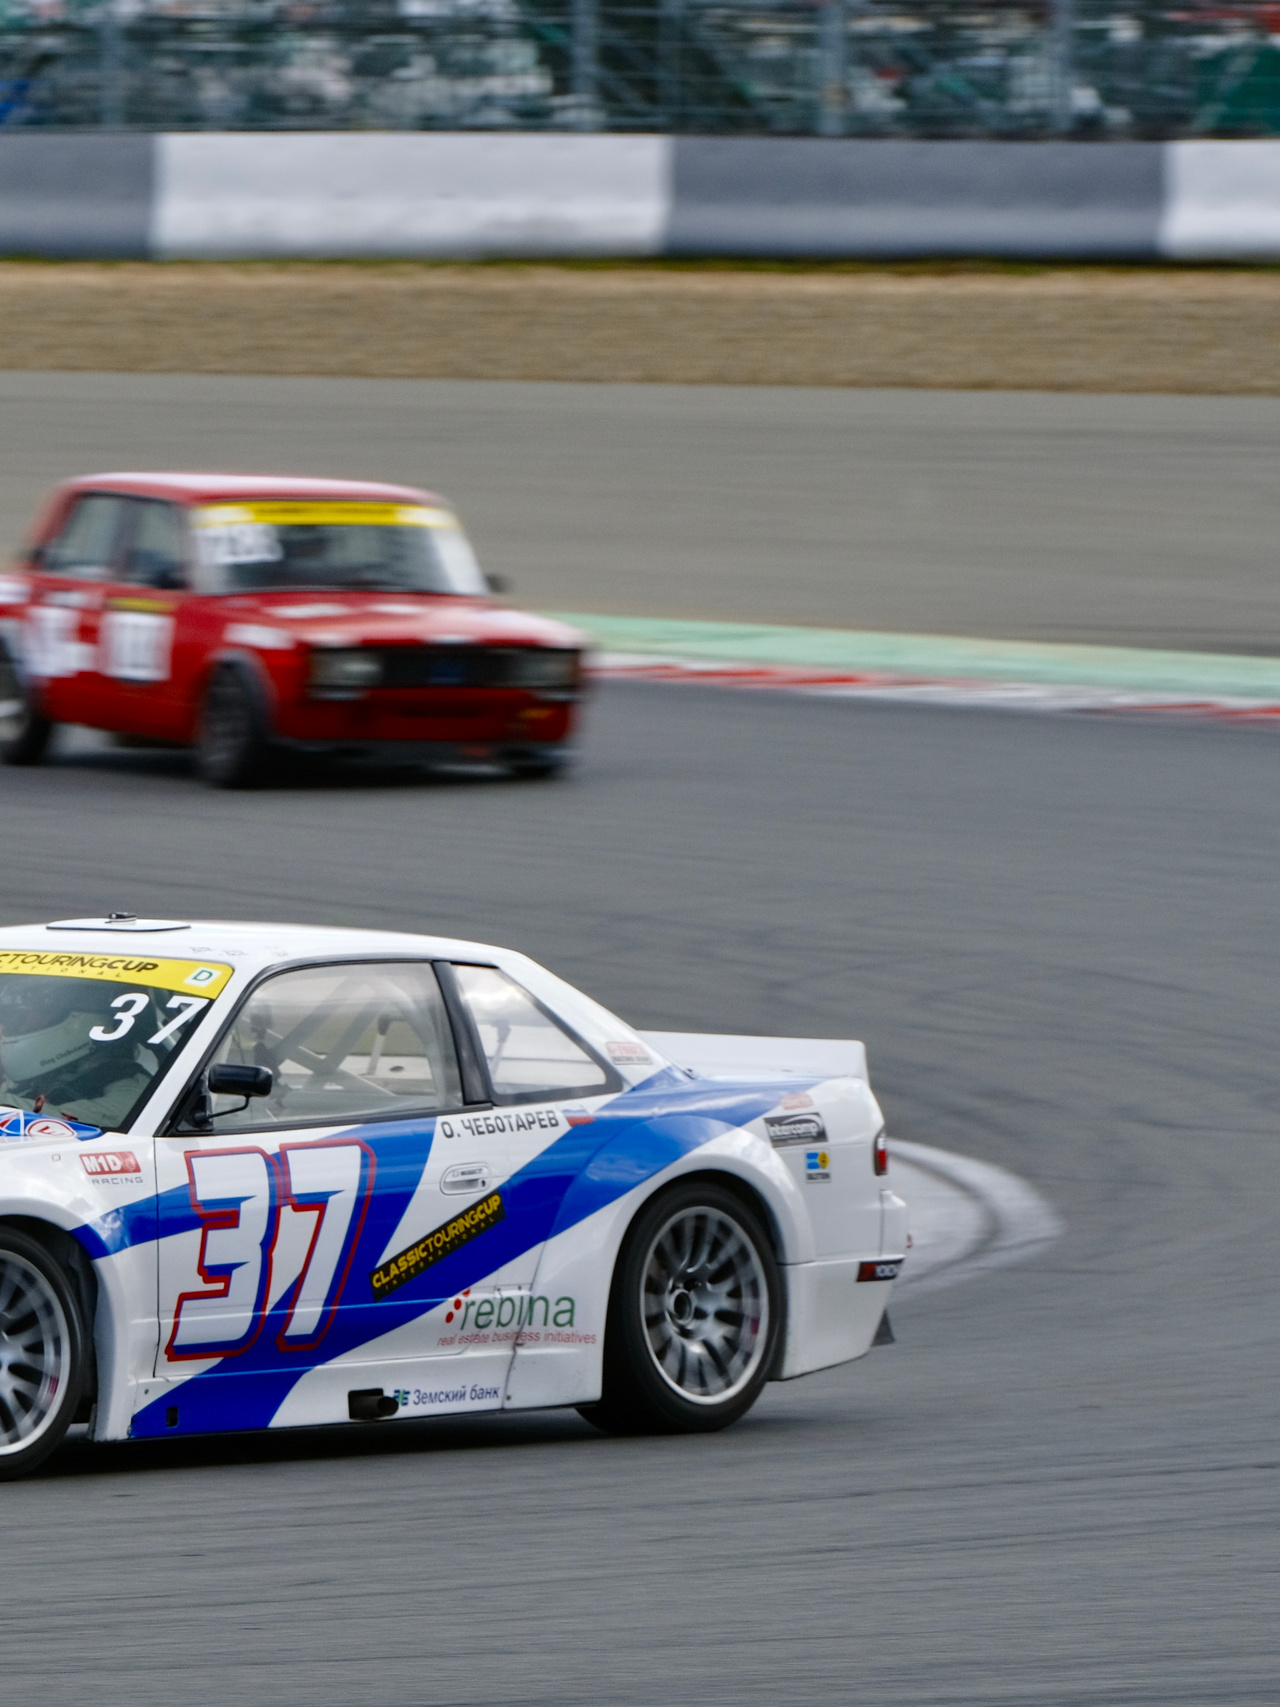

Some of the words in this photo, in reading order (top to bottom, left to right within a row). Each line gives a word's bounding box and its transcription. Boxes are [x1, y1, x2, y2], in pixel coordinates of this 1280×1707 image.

[192, 969, 213, 982] D
[88, 992, 210, 1045] 37
[460, 1110, 560, 1137] ЧЕБОТАРЕВ
[91, 1176, 144, 1186] RACING
[165, 1138, 377, 1362] 37
[372, 1194, 501, 1288] CLASSICTOURINGCUP
[460, 1286, 576, 1331] rebina
[437, 1333, 458, 1347] real
[458, 1331, 490, 1345] estate
[543, 1329, 598, 1344] initiatives
[412, 1384, 467, 1406] Земский
[469, 1383, 500, 1401] банк
